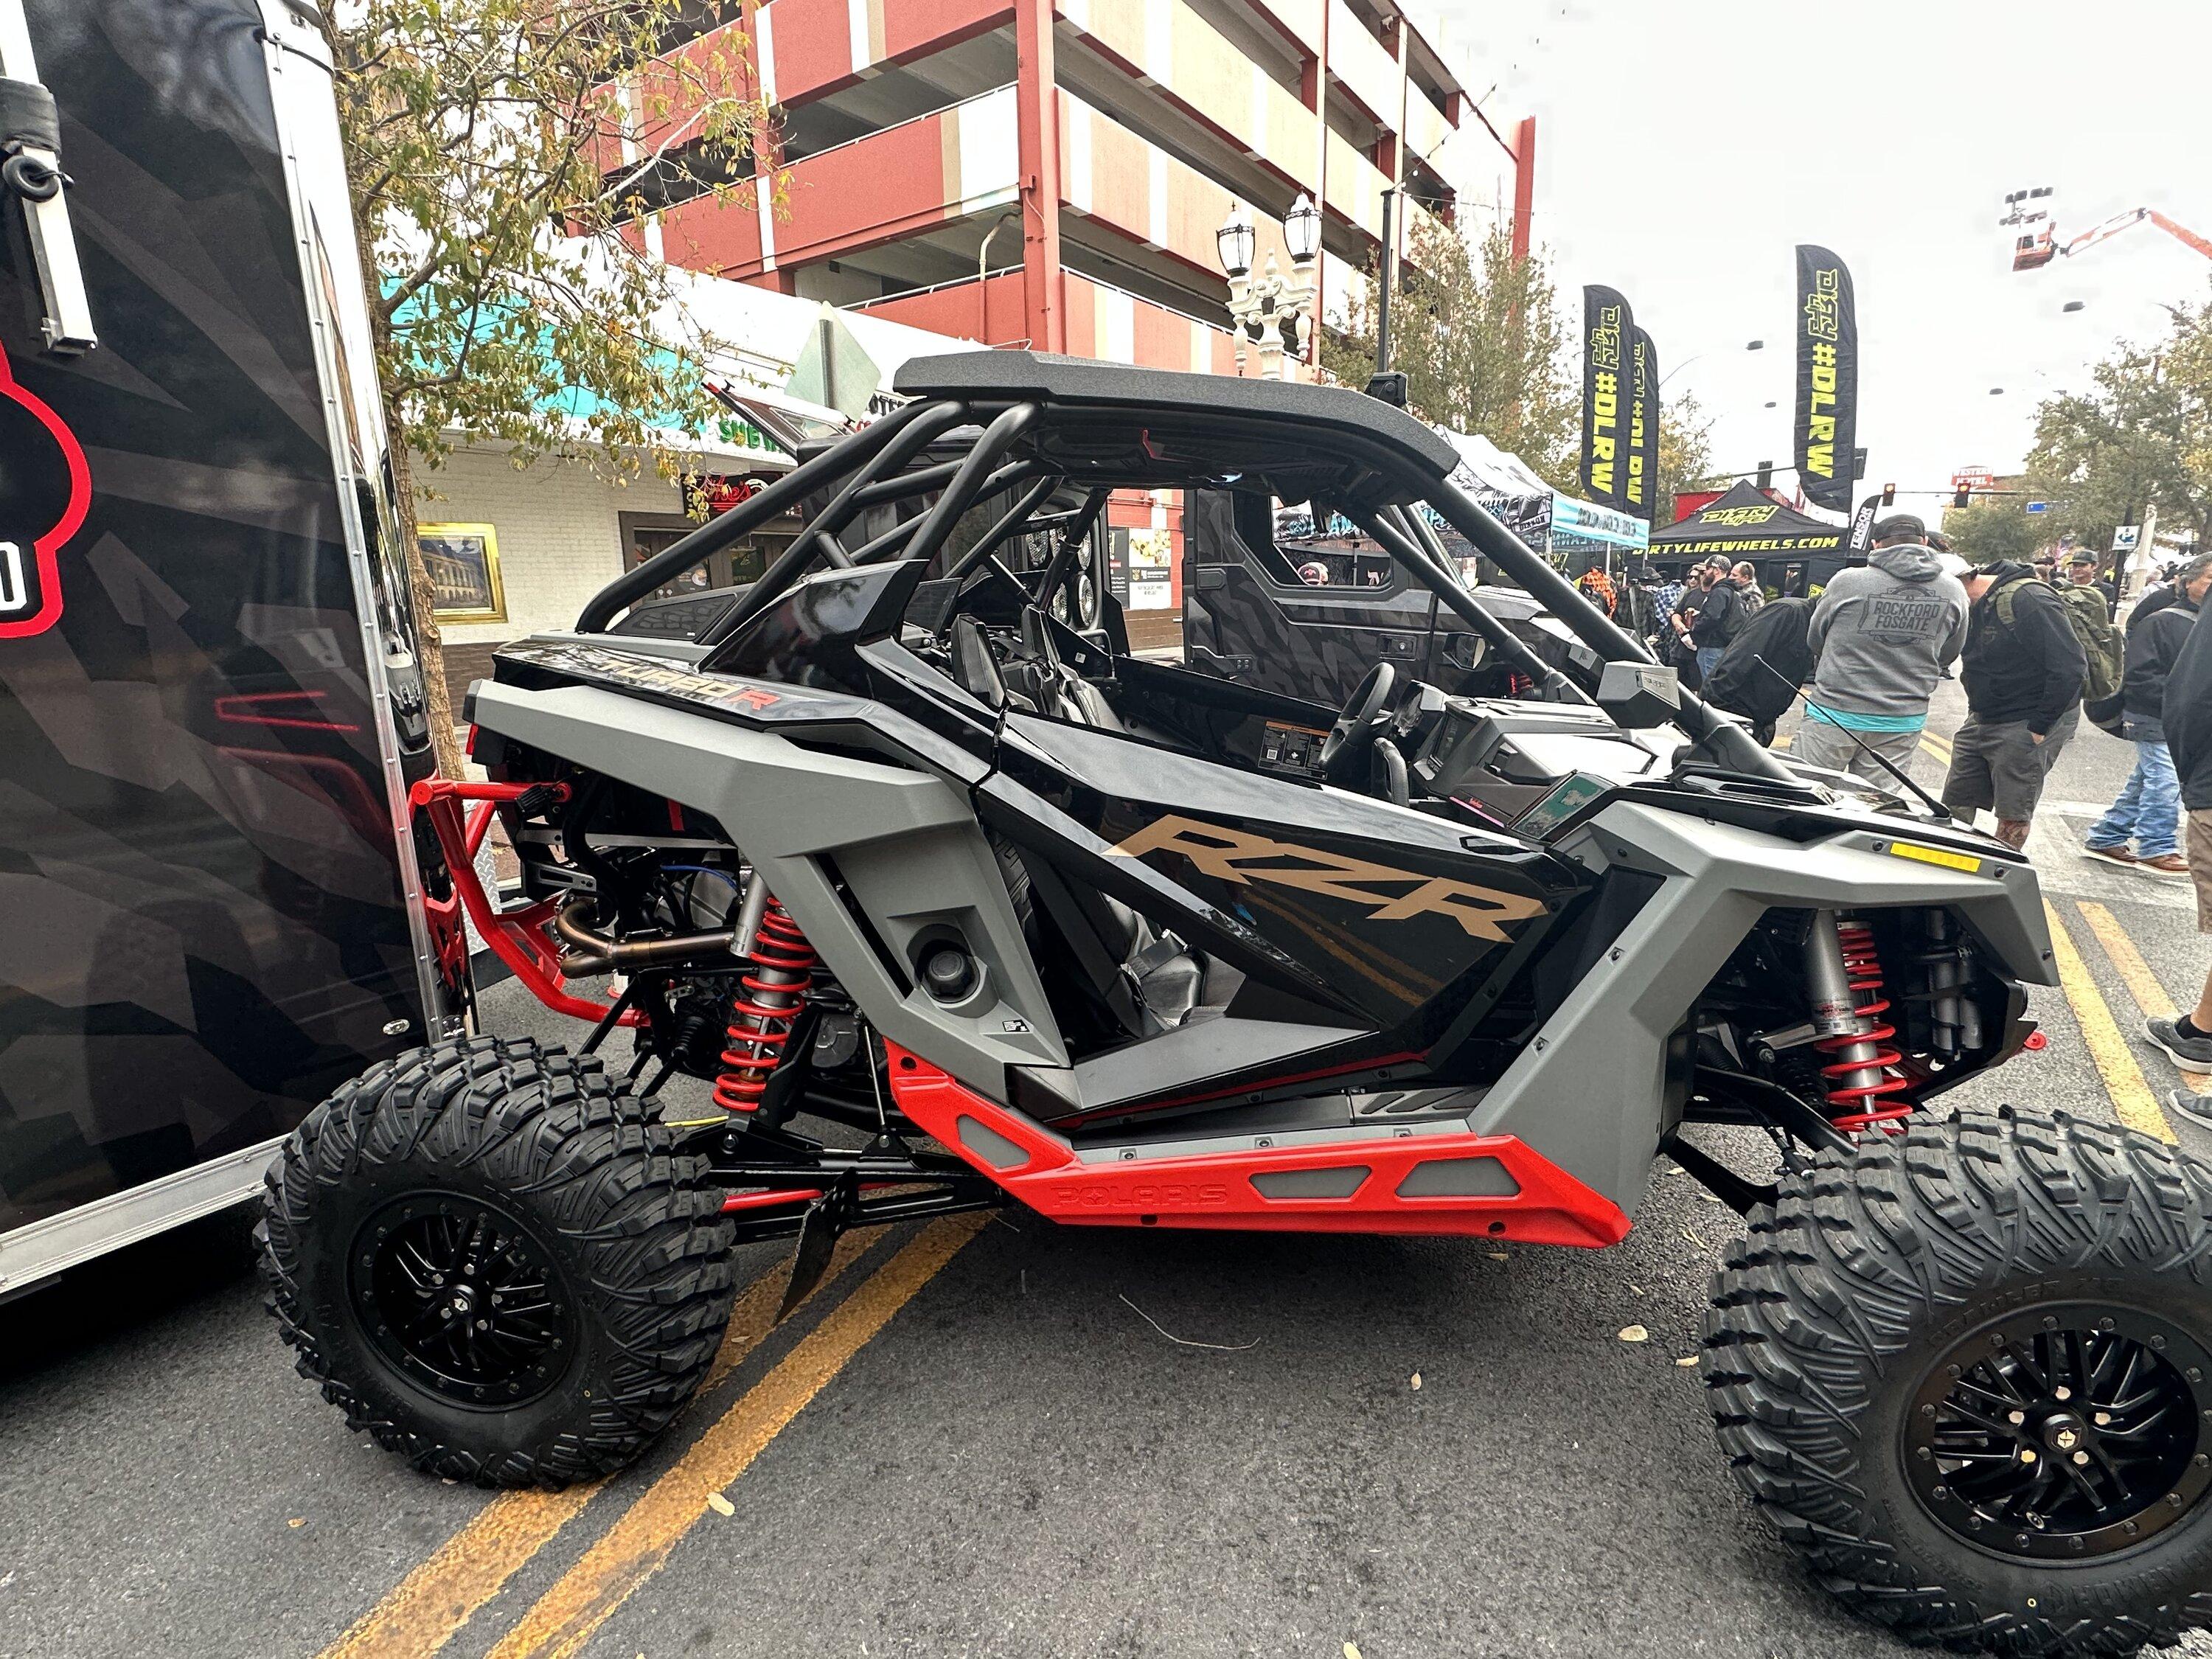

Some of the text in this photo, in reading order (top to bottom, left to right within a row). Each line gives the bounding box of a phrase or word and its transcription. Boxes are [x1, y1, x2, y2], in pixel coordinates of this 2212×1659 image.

[1590, 371, 1618, 495] #DLRW
[1807, 342, 1837, 479] #DLRW
[1849, 507, 1867, 549] TENSOR
[1874, 601, 1941, 619] ROCKFORD
[1875, 615, 1932, 631] FOSGATE
[598, 659, 781, 711] TURBO R
[1100, 813, 1548, 944] RZR
[1050, 1183, 1228, 1208] POLARIS
